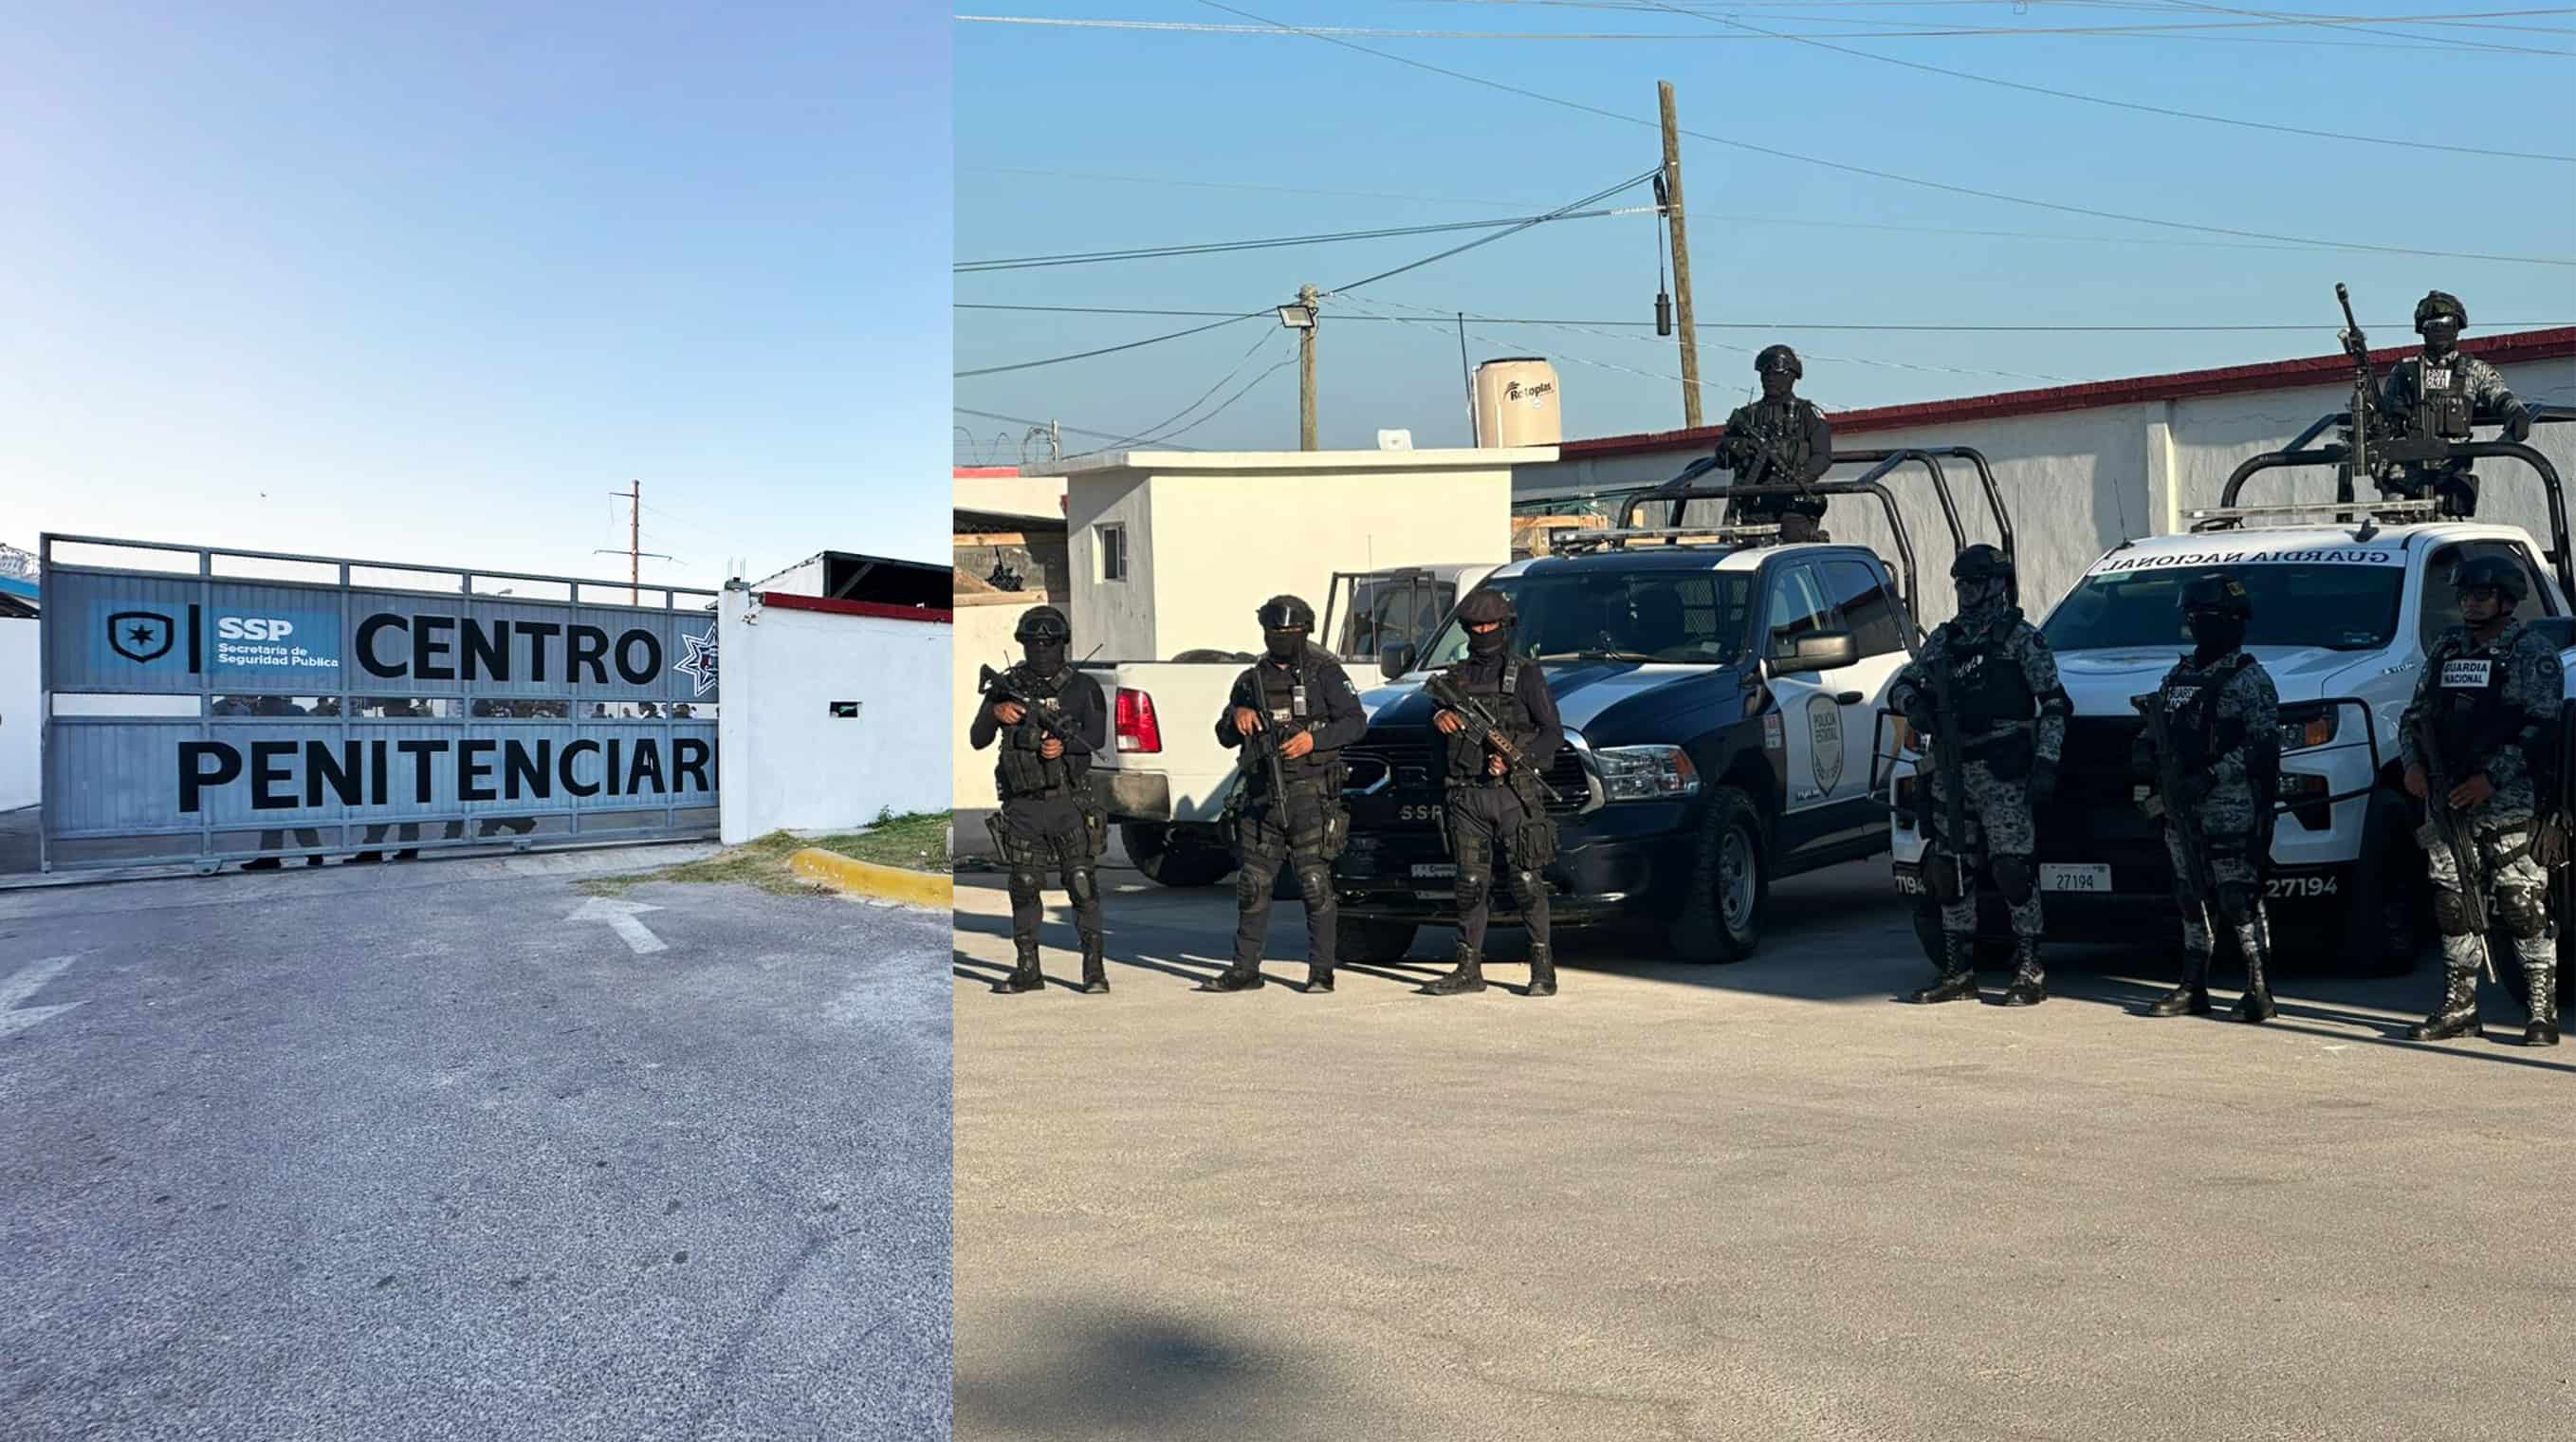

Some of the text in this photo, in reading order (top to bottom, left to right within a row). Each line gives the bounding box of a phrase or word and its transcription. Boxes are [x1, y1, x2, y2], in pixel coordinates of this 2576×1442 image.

[218, 617, 293, 641] SSP
[291, 646, 308, 656] de
[356, 613, 662, 685] CENTRO
[218, 654, 288, 666] Seguridad
[2444, 662, 2488, 673] GUARDIA
[2055, 874, 2094, 890] 27194
[2265, 876, 2338, 897] 27194
